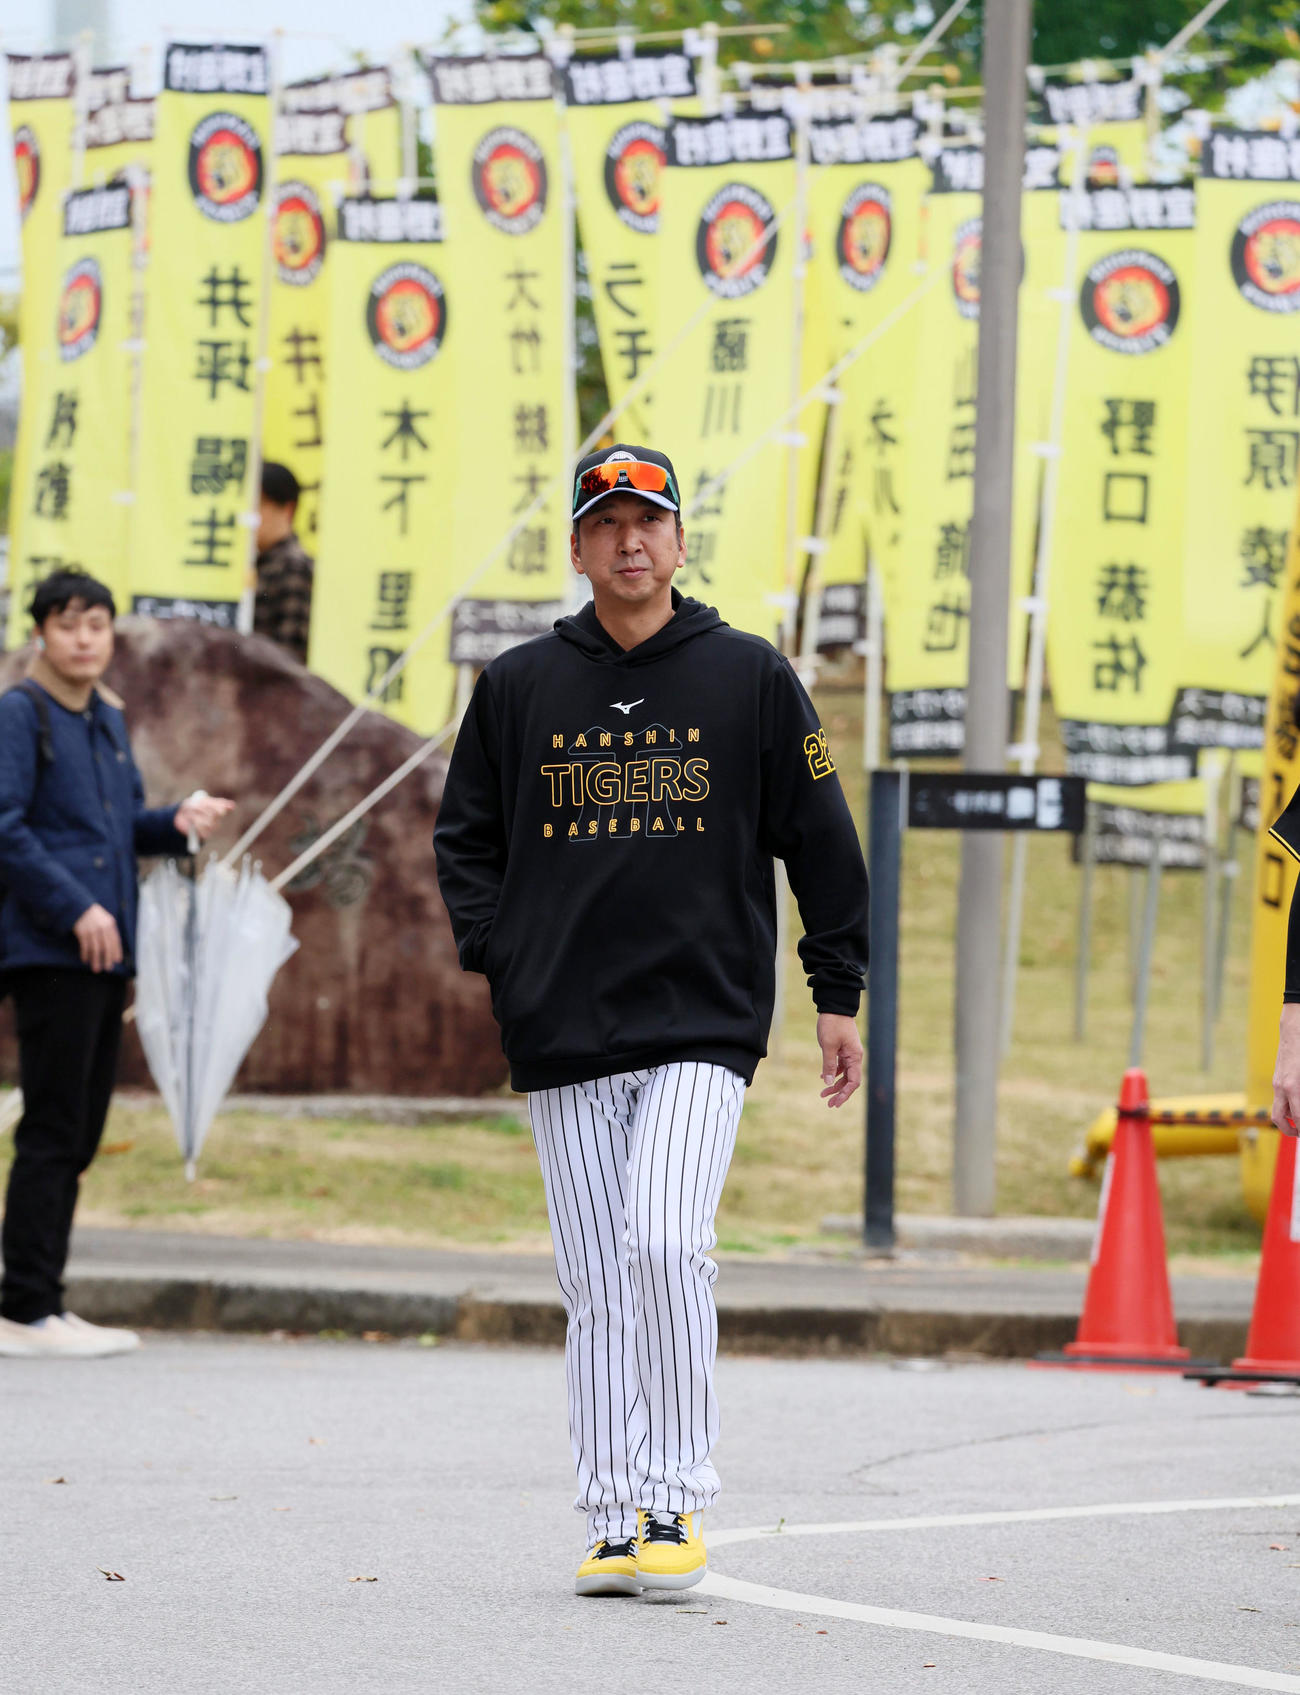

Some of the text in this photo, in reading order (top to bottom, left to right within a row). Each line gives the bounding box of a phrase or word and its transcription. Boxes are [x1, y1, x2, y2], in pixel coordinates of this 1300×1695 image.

[552, 728, 700, 749] HANSHIN
[541, 758, 710, 807] TIGERS
[543, 817, 705, 839] BASEBALL
